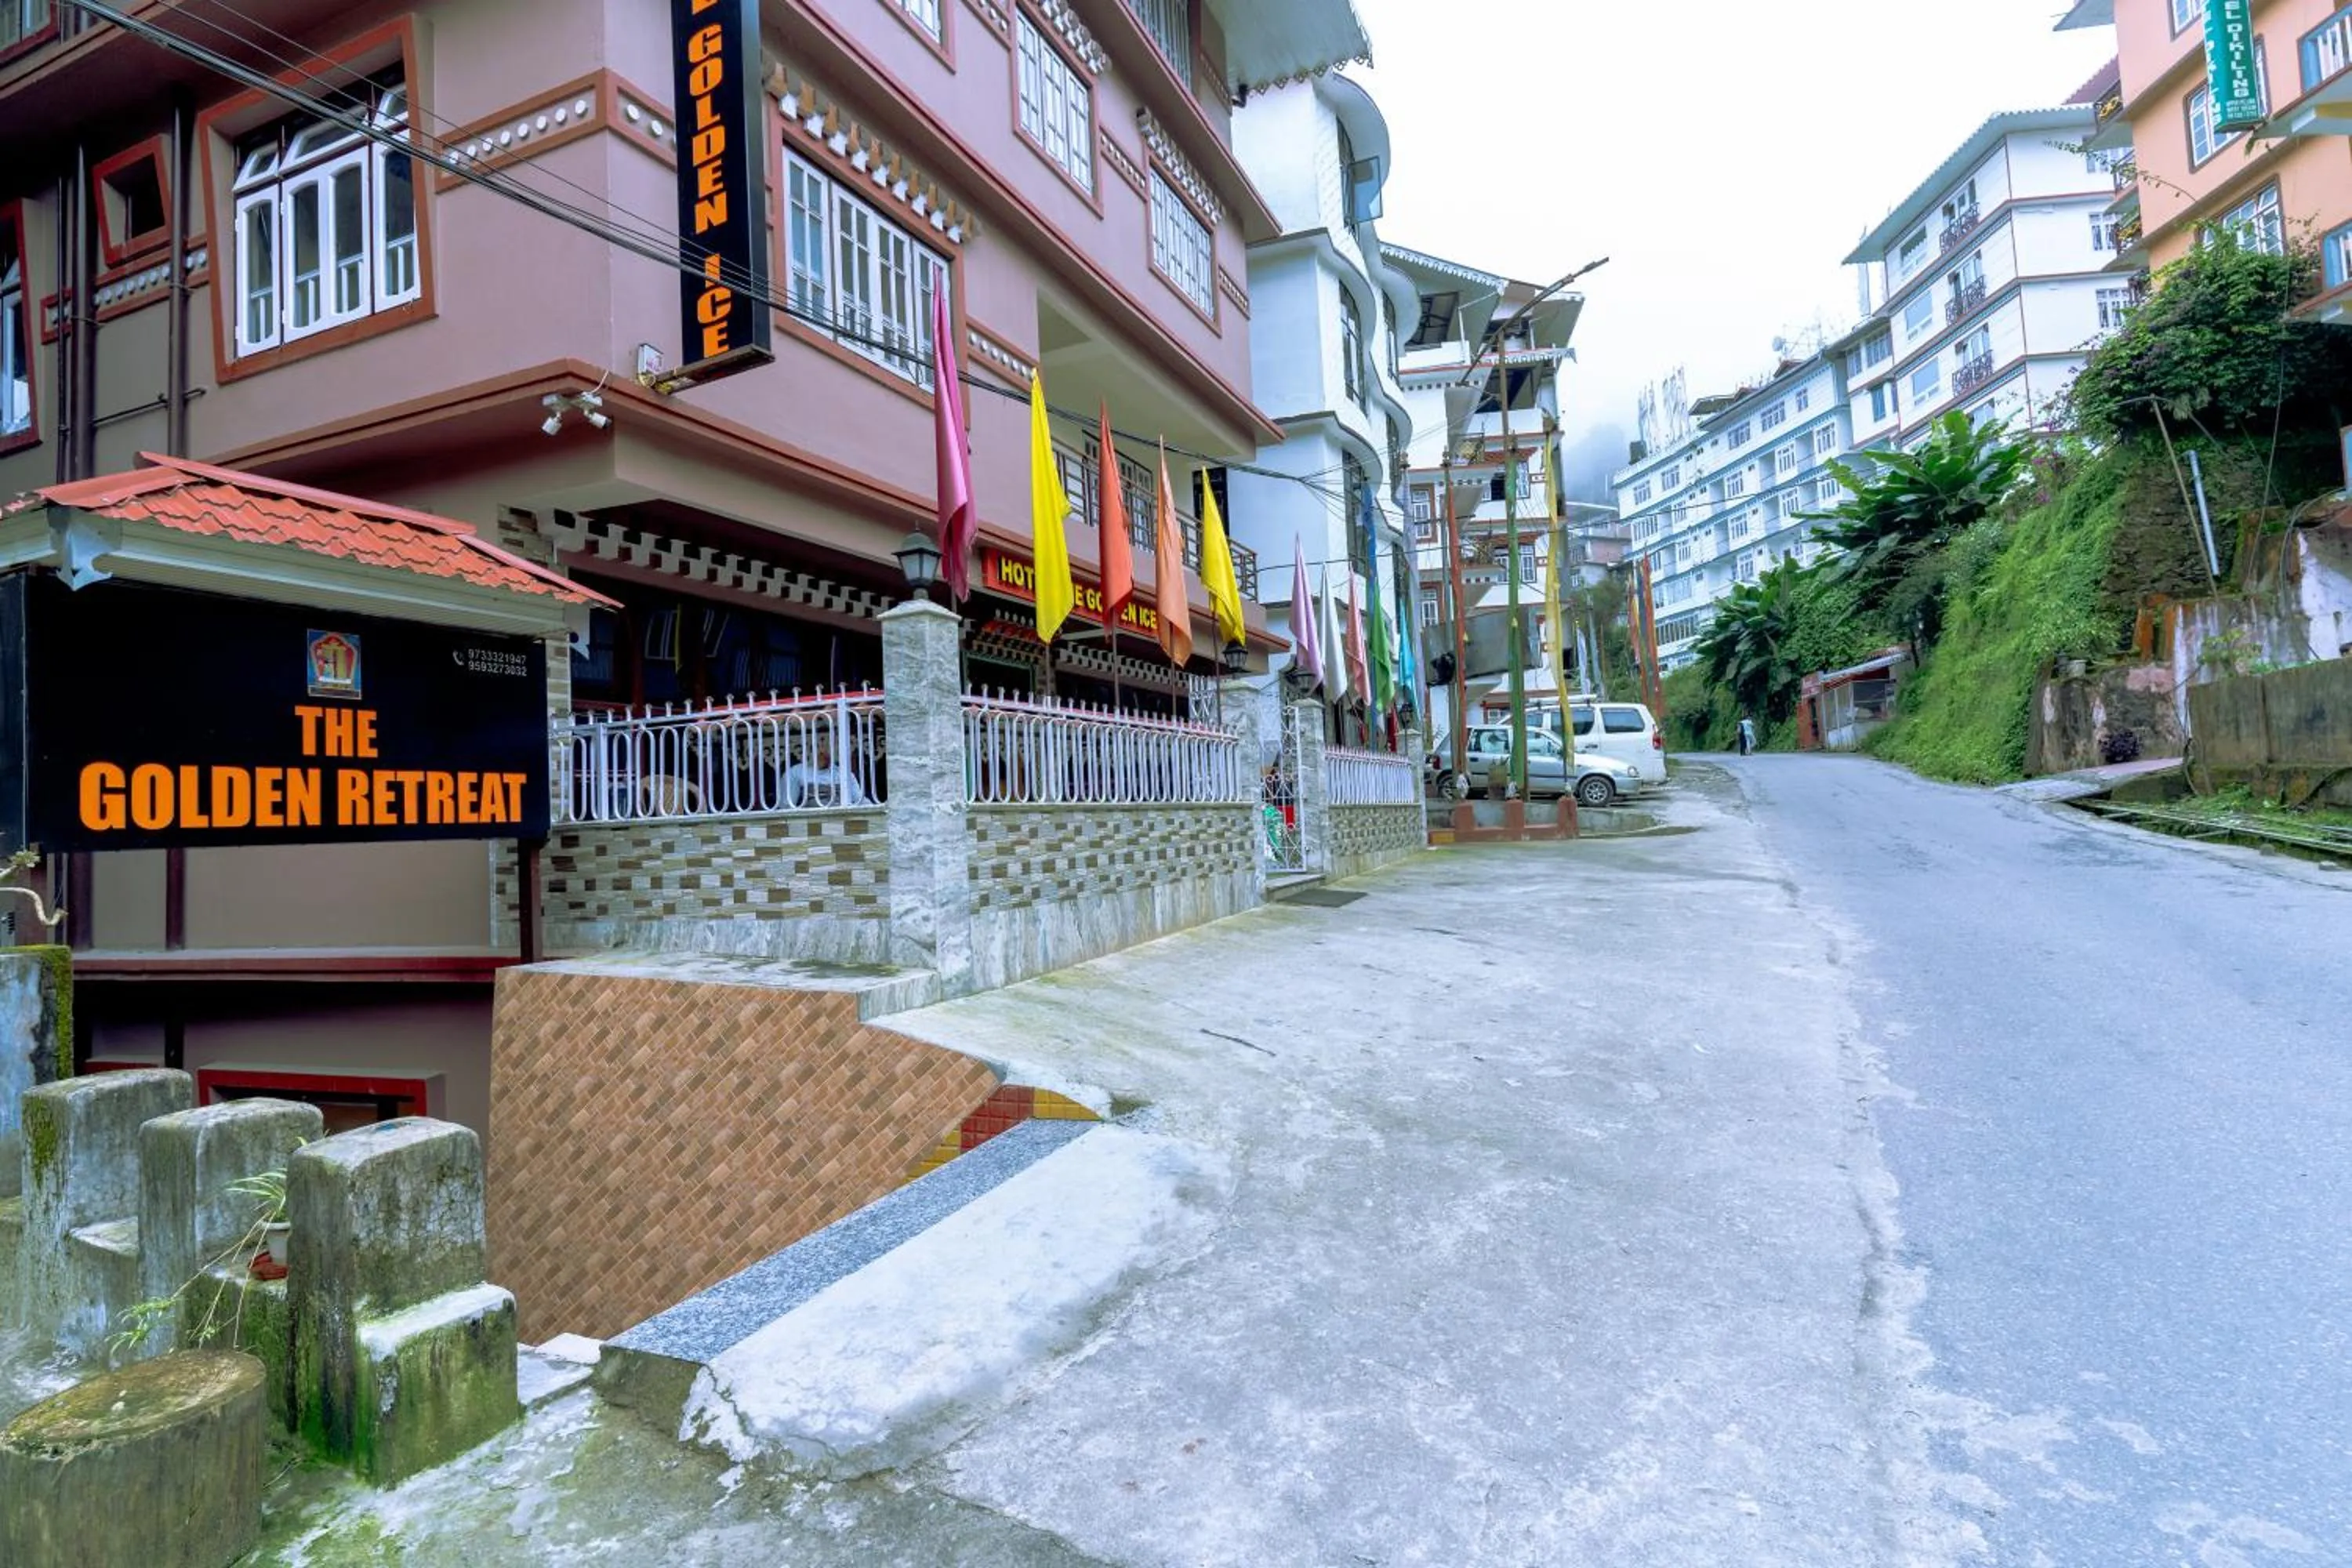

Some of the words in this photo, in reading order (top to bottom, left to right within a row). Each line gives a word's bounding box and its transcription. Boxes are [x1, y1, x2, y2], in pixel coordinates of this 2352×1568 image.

[688, 23, 728, 234] GOLDEN
[696, 252, 732, 358] ICE
[1001, 556, 1035, 590] HOT
[1086, 587, 1137, 624] GOEN
[1139, 607, 1157, 629] ICE
[295, 705, 379, 758] THE
[79, 762, 321, 831] GOLDEN
[337, 768, 528, 826] RETREAT
